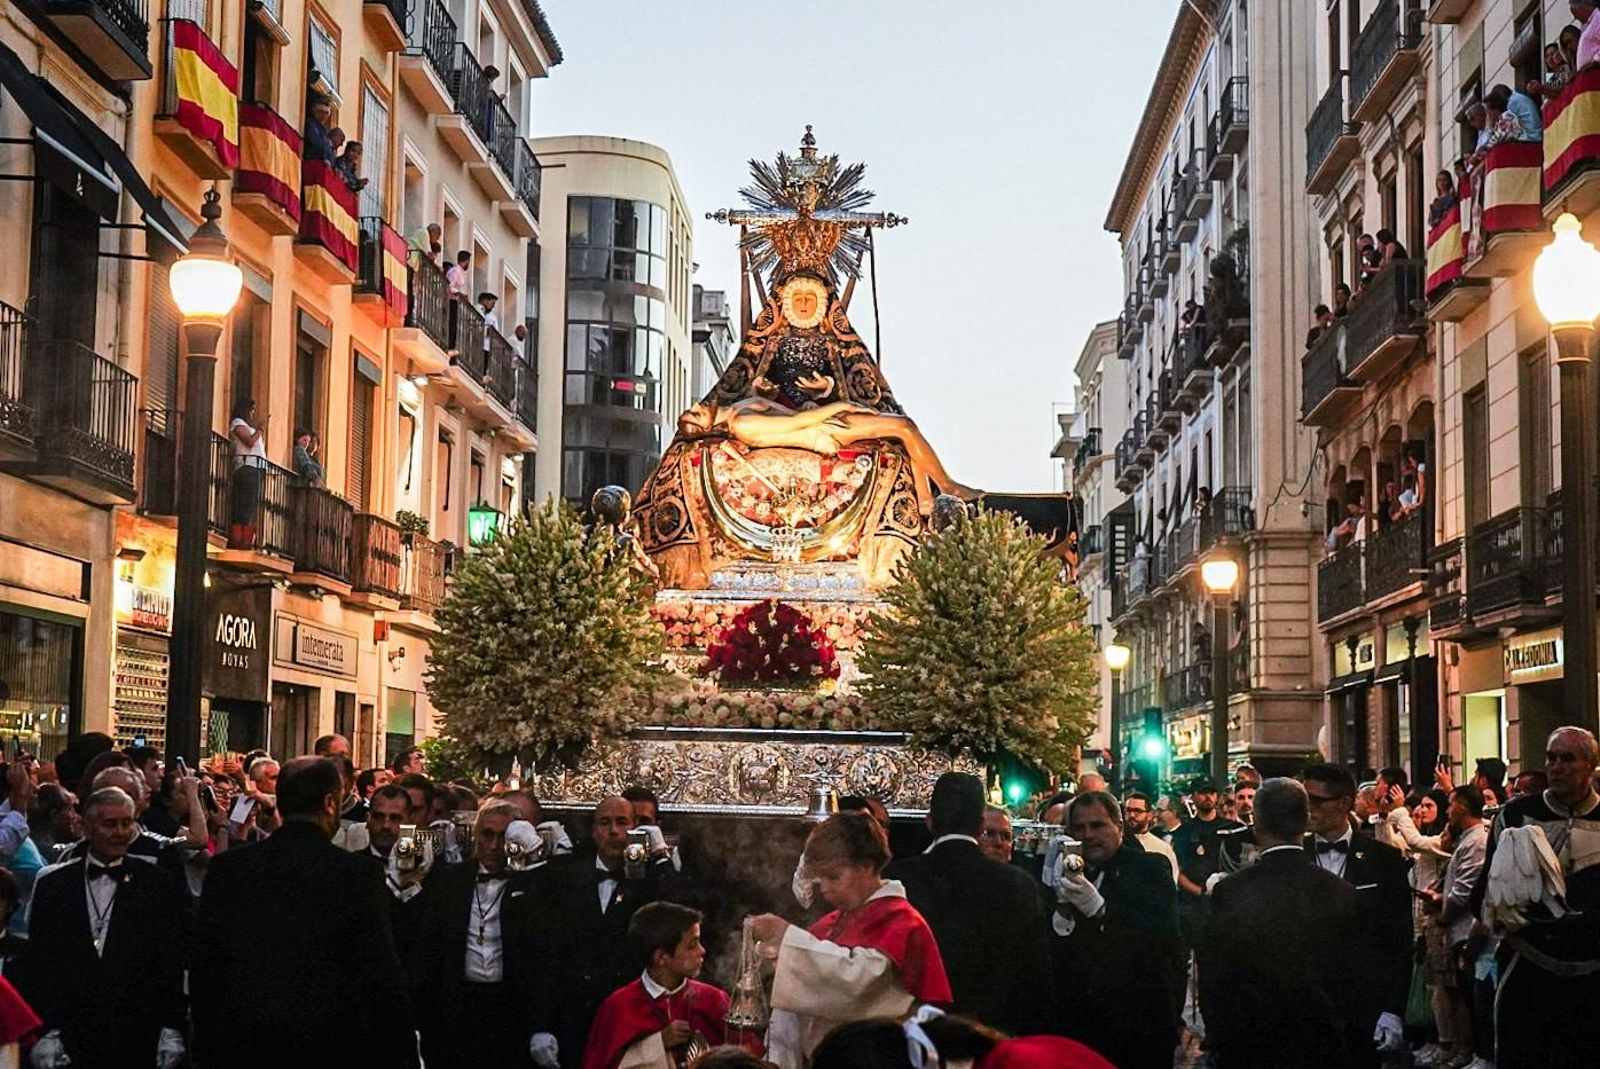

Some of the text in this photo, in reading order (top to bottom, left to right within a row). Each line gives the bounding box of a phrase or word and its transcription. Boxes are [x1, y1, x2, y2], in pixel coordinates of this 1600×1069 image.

[216, 613, 257, 650] AGORA
[302, 628, 344, 662] intemerata
[221, 652, 249, 669] JOYAS
